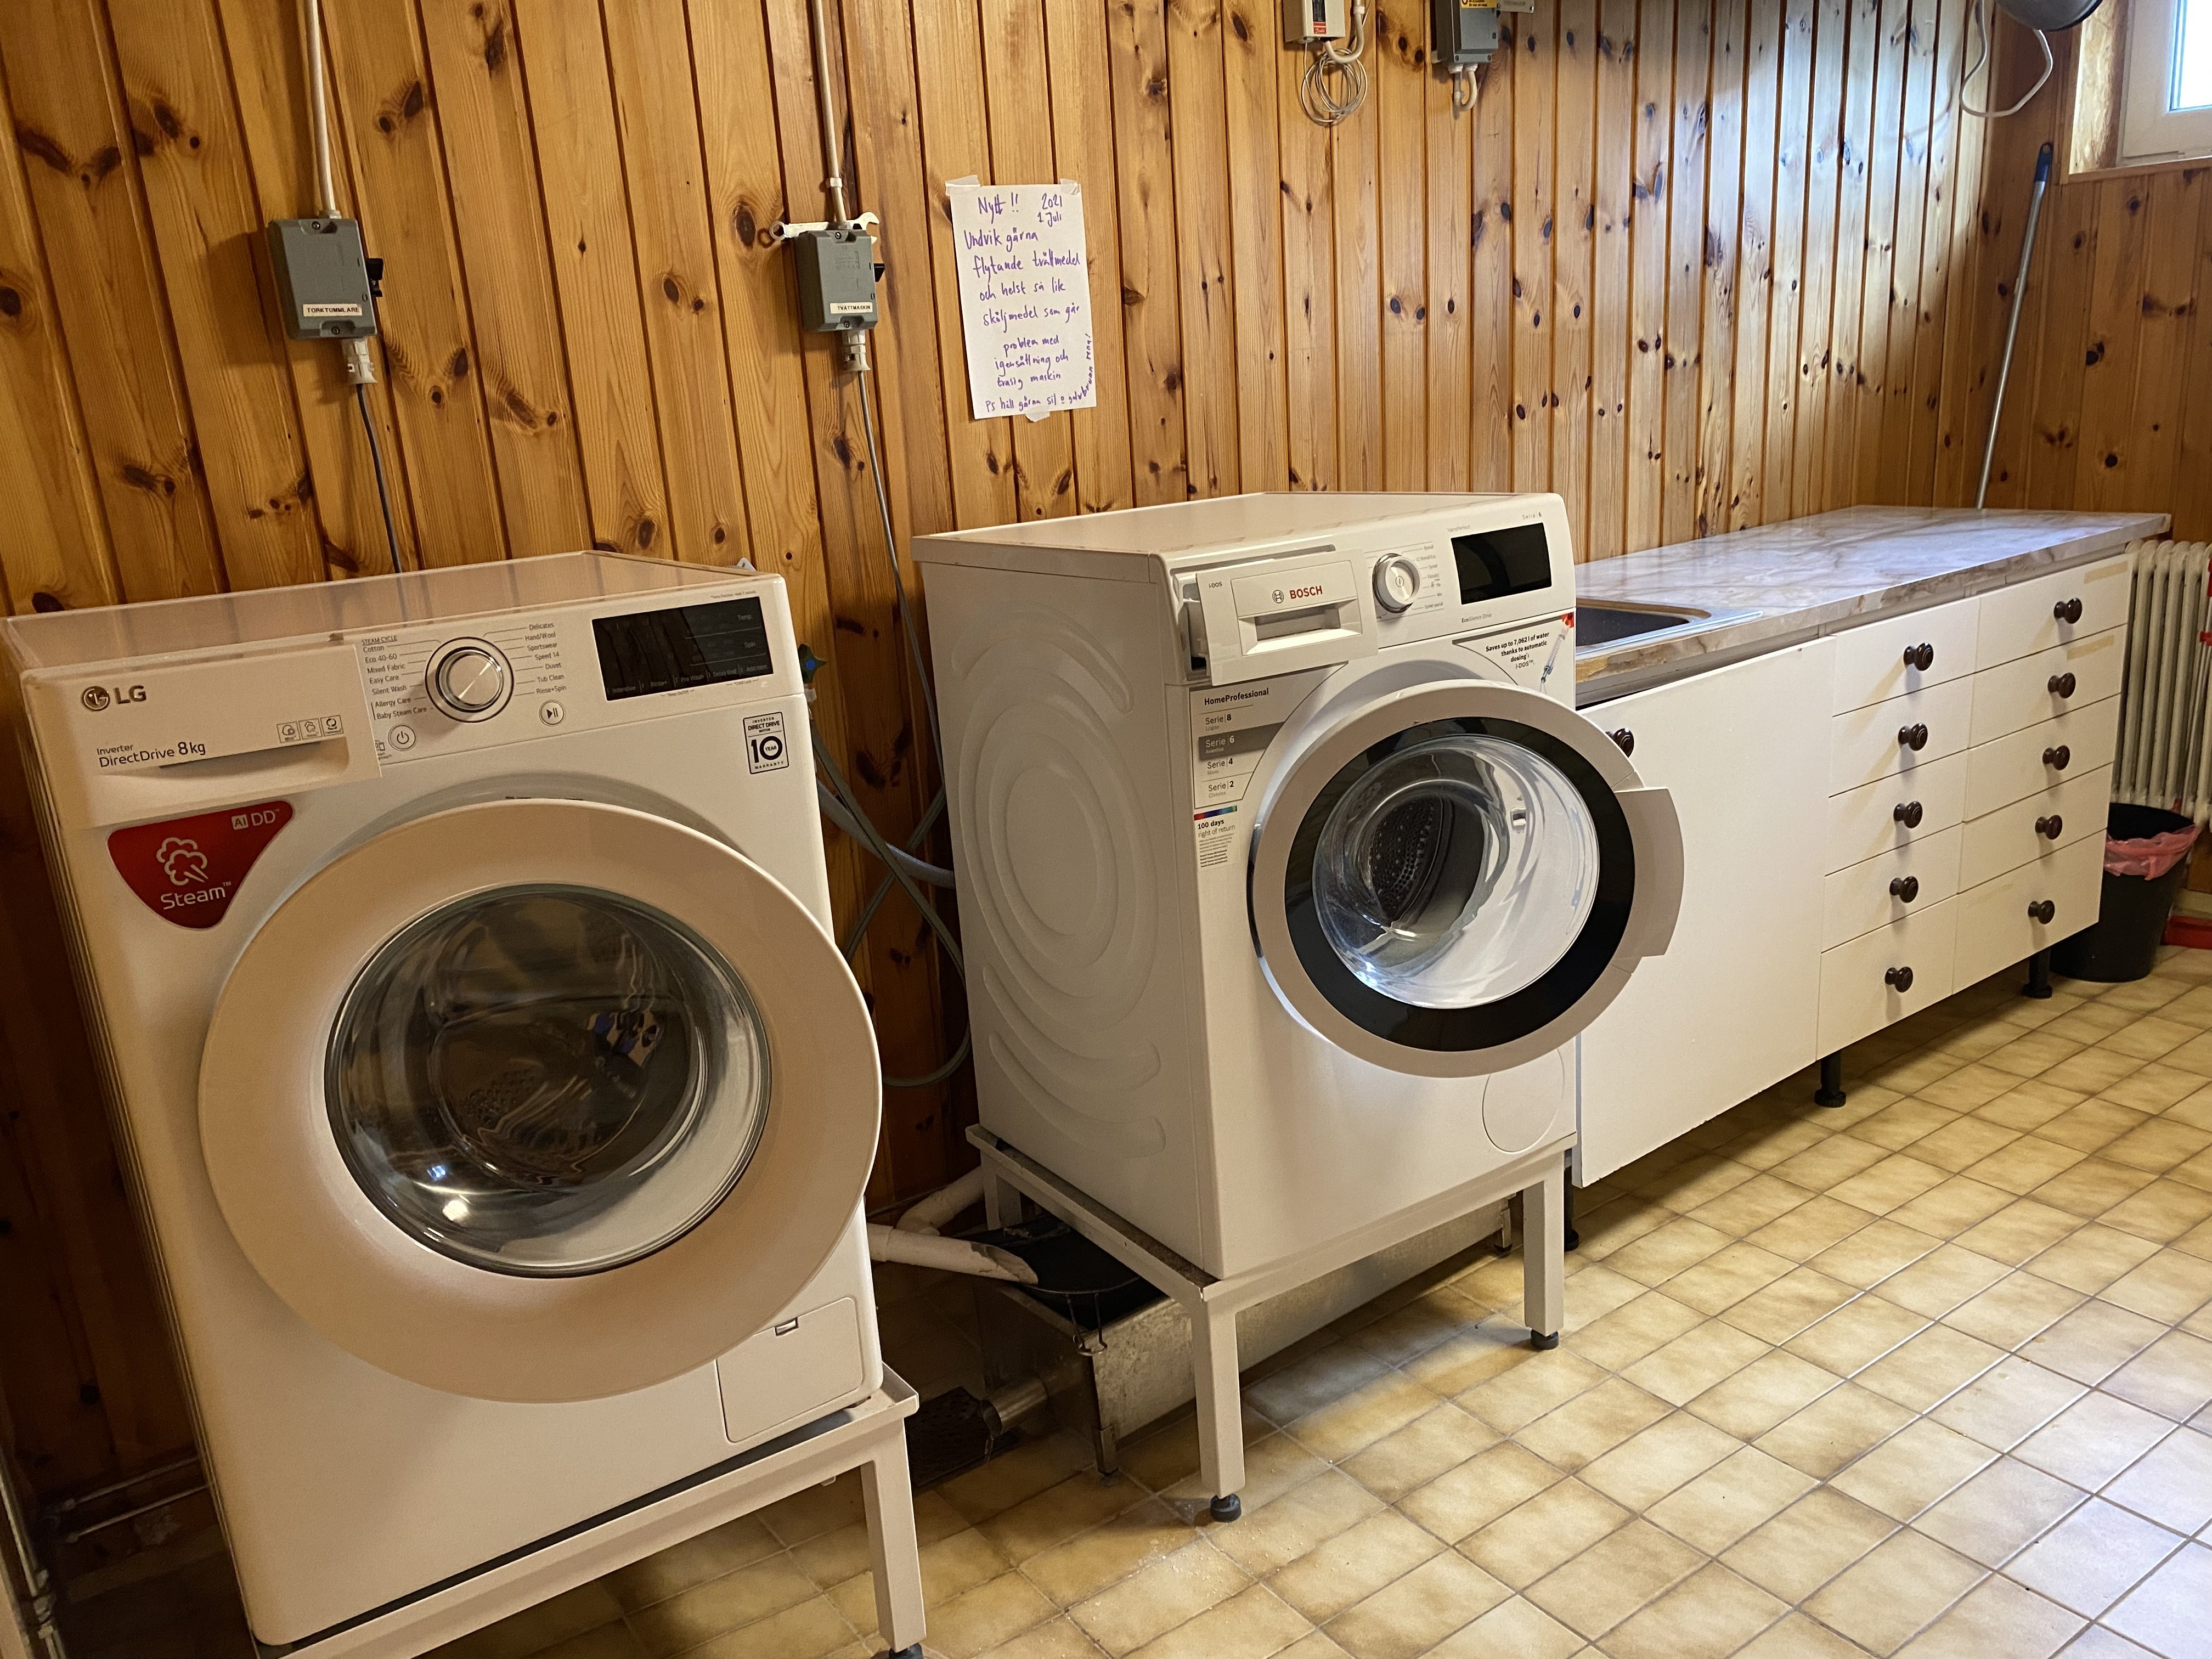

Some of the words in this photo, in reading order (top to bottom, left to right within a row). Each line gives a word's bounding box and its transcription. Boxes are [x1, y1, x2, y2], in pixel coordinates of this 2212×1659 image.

[1042, 193, 1062, 210] 2021
[978, 194, 1006, 224] Nytt
[1037, 212, 1043, 223] 1
[1046, 211, 1062, 227] Juli
[964, 228, 1002, 250] Undvik
[1006, 228, 1038, 252] gärna
[973, 255, 1024, 283] flytande
[1032, 249, 1080, 267] tvättmedel
[980, 284, 996, 301] och
[1001, 281, 1026, 295] helst
[983, 304, 1038, 333] sköljmedel
[1044, 308, 1060, 317] som
[1003, 337, 1038, 358] problem
[1042, 334, 1059, 345] med
[994, 353, 1051, 377] igensättning
[1056, 348, 1068, 363] och
[997, 376, 1023, 390] trasig
[1030, 371, 1061, 382] maskin
[1289, 585, 1323, 599] BOSCH
[524, 631, 556, 641] Hand/Wool
[1536, 631, 1549, 640] water
[363, 645, 384, 653] Cotton
[527, 642, 557, 651] Sportswear
[1524, 640, 1547, 650] automatic
[534, 652, 551, 661] Speed
[367, 665, 385, 674] Mixed
[387, 663, 405, 672] Fabric
[114, 685, 146, 704] LG
[1204, 687, 1269, 706] HomeProfessional
[1205, 715, 1223, 725] Serie
[1206, 737, 1226, 748] Serie
[97, 744, 133, 755] Inverter
[751, 736, 782, 763] 10
[755, 761, 783, 769] WARRANTY
[1207, 759, 1225, 769] Serie
[1208, 782, 1226, 792] Serie
[1198, 830, 1210, 838] right
